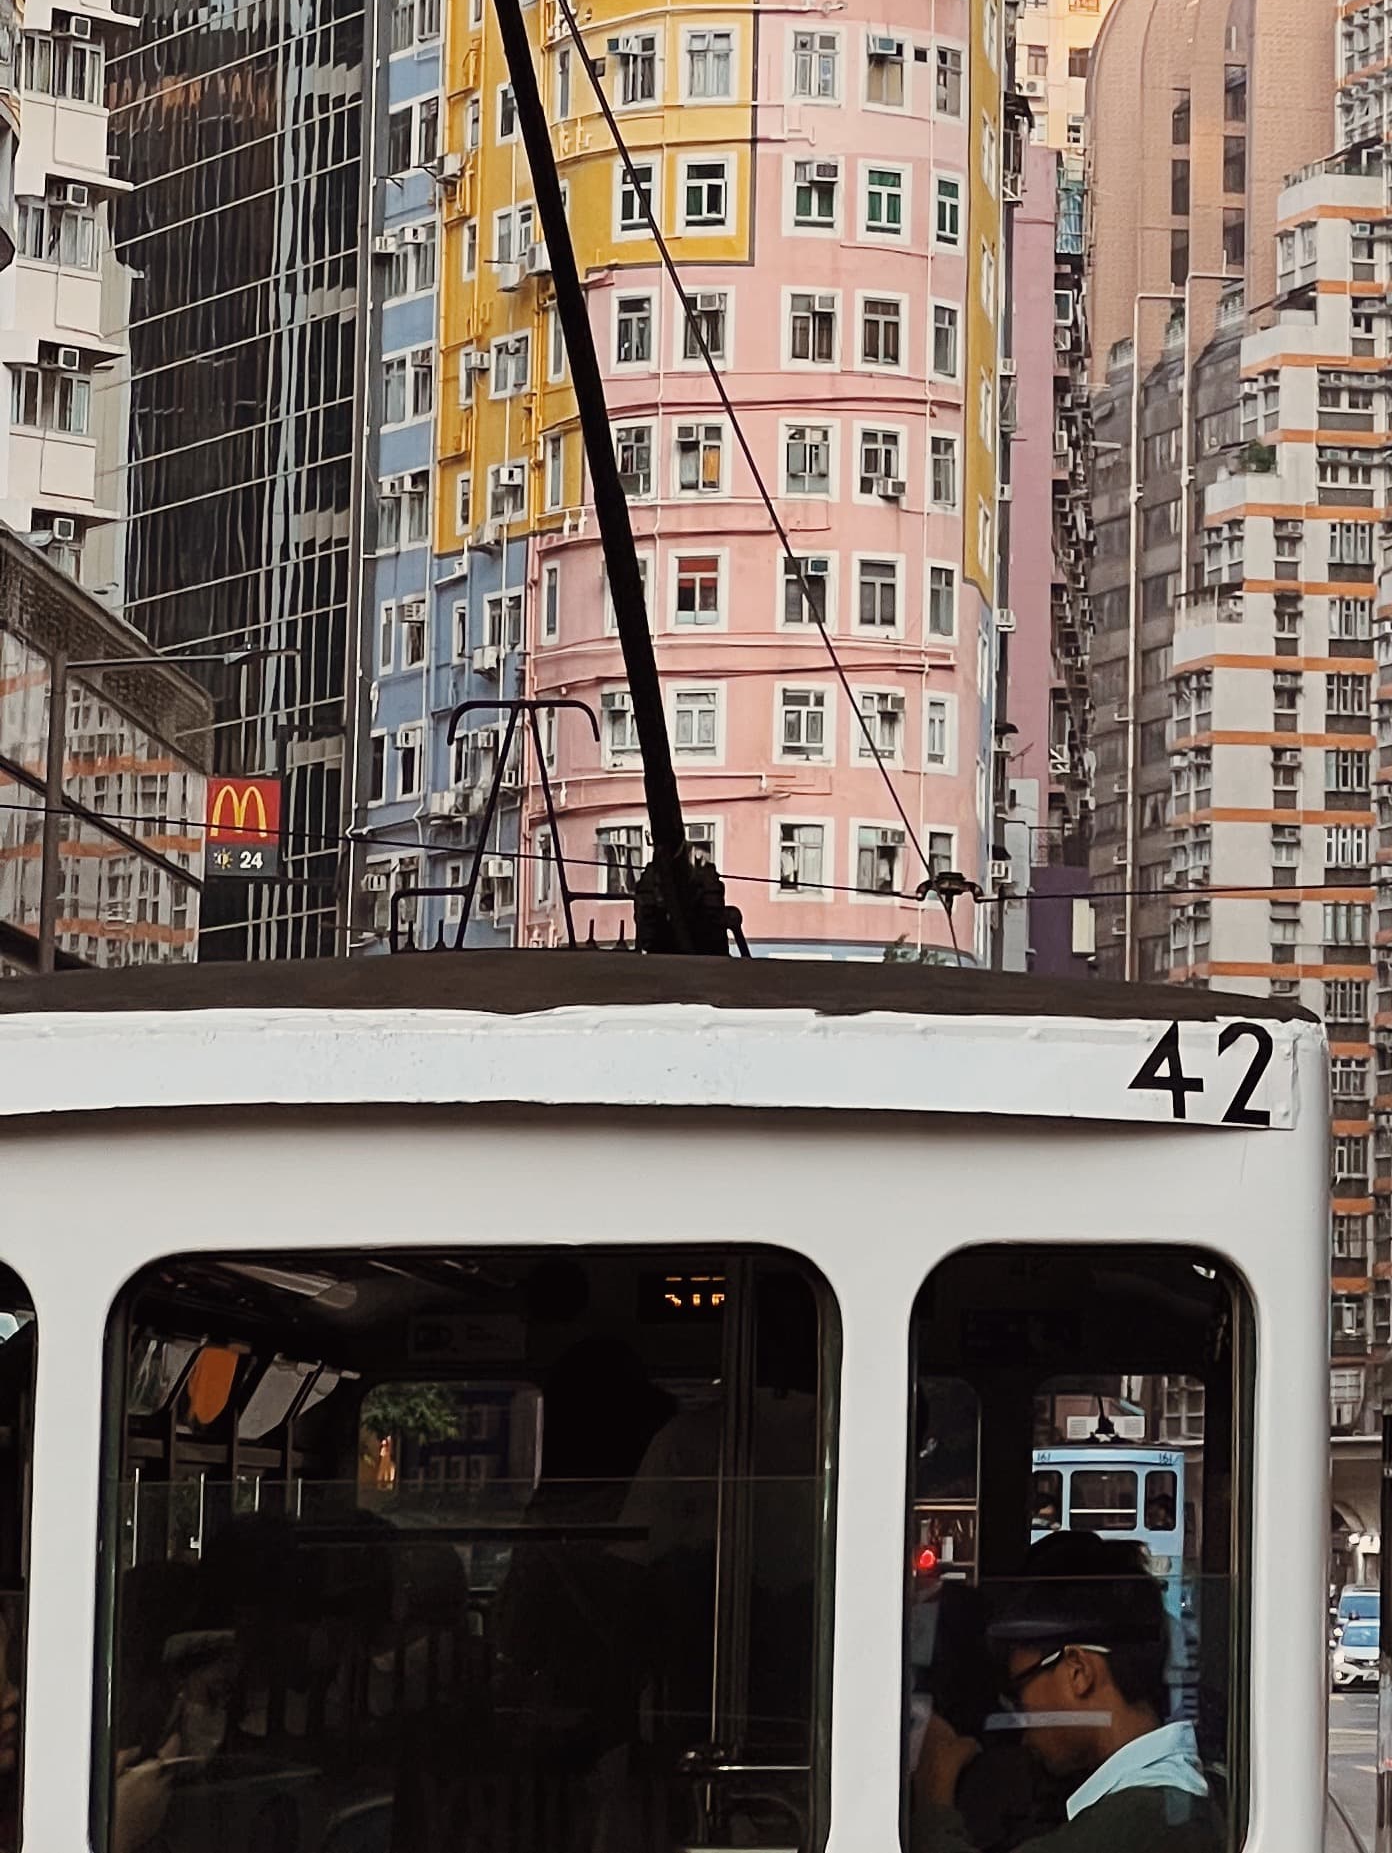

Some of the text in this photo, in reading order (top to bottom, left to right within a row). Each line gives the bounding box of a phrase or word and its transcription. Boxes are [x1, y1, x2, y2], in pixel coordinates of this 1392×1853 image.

[240, 850, 263, 869] 24
[1127, 1021, 1274, 1127] 42
[1036, 1452, 1052, 1462] 161
[1158, 1452, 1173, 1465] 161
